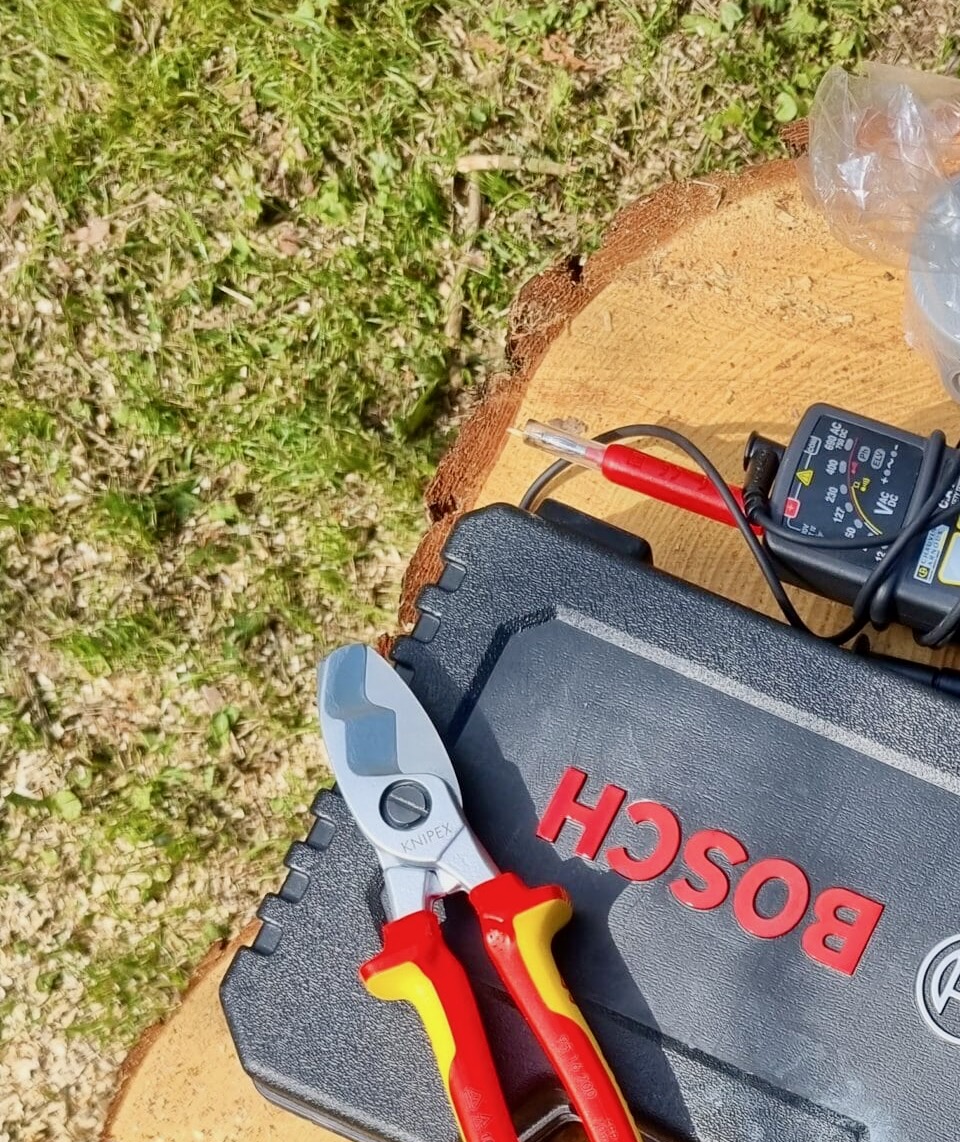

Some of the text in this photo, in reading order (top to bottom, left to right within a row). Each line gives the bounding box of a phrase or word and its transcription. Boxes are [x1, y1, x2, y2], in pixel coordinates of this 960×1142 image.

[829, 422, 842, 435] AC
[825, 459, 838, 475] 400
[825, 486, 838, 503] 230
[833, 507, 845, 523] 127
[845, 527, 856, 539] 50
[400, 822, 452, 853] KNIPEX
[536, 765, 885, 976] BOSCH
